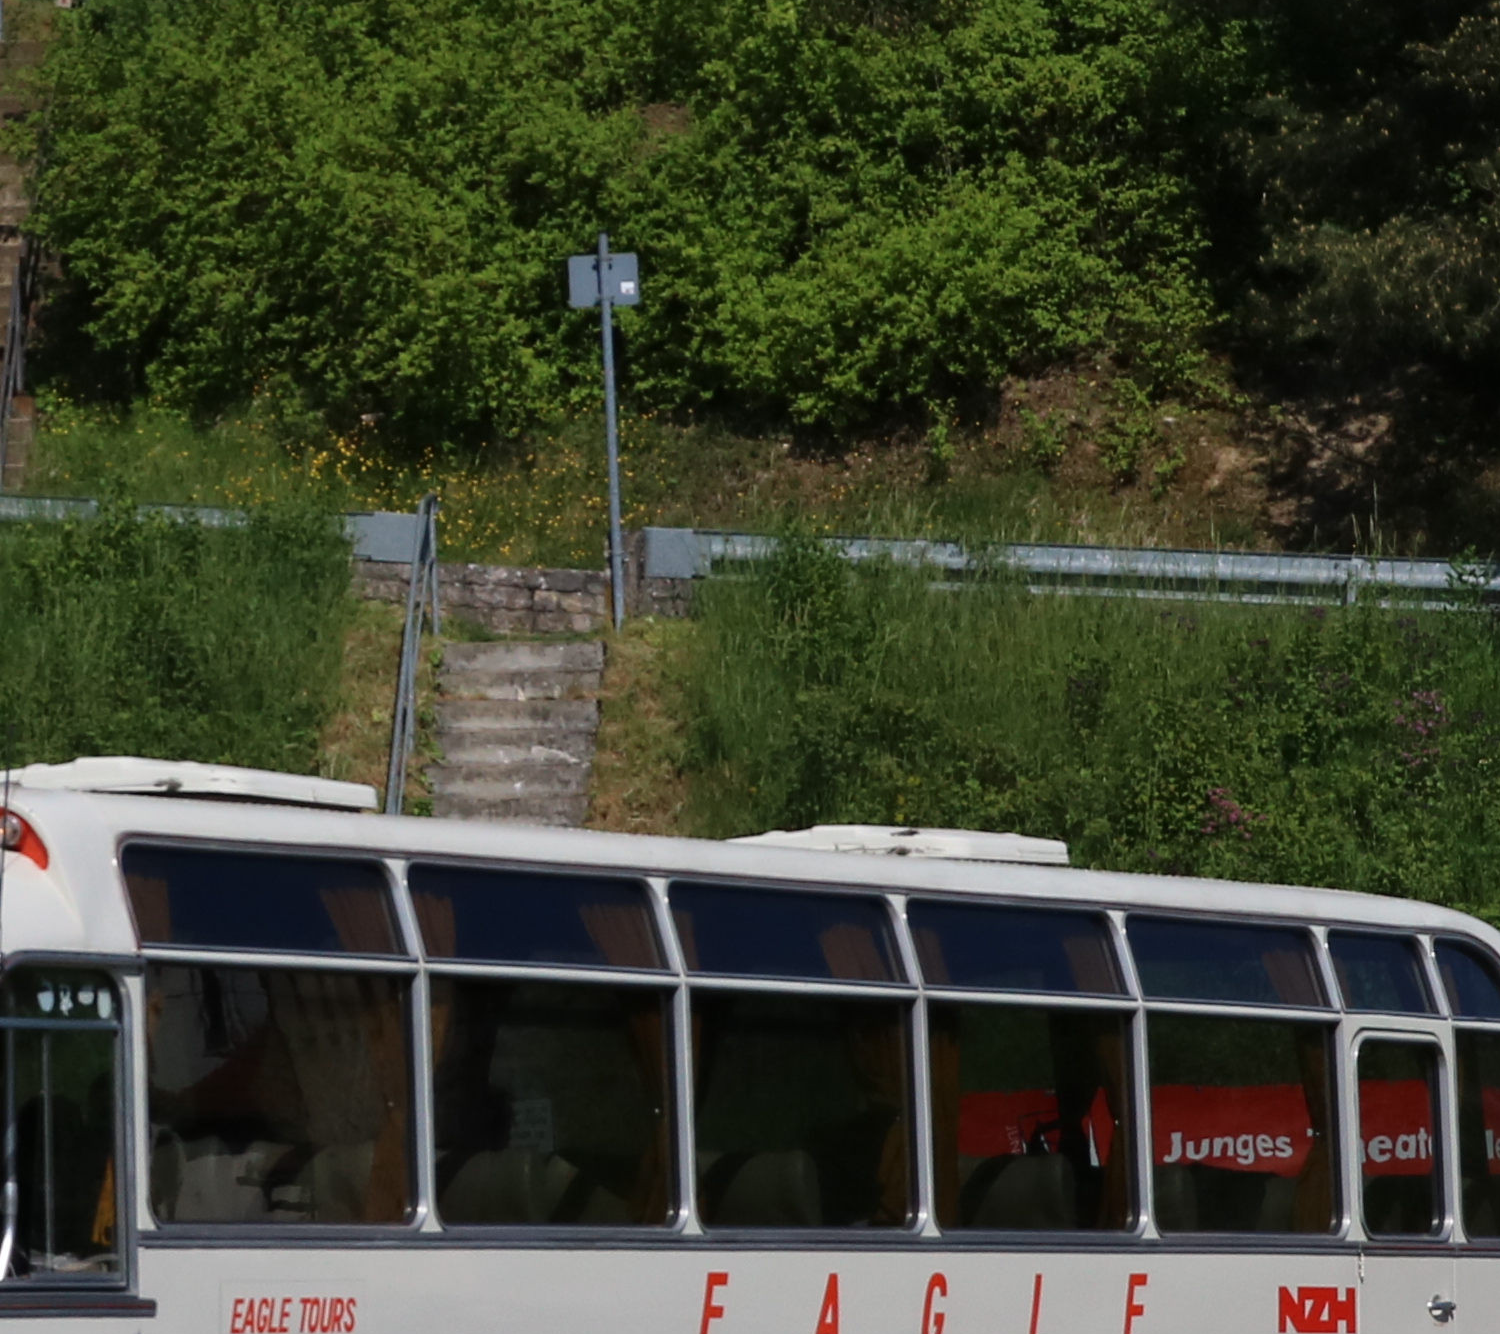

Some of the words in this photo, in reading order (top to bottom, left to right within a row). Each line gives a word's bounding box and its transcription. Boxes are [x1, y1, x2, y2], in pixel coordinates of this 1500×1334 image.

[1163, 1131, 1293, 1165] Junges
[299, 1296, 358, 1334] TOURS
[1278, 1286, 1357, 1334] NZH
